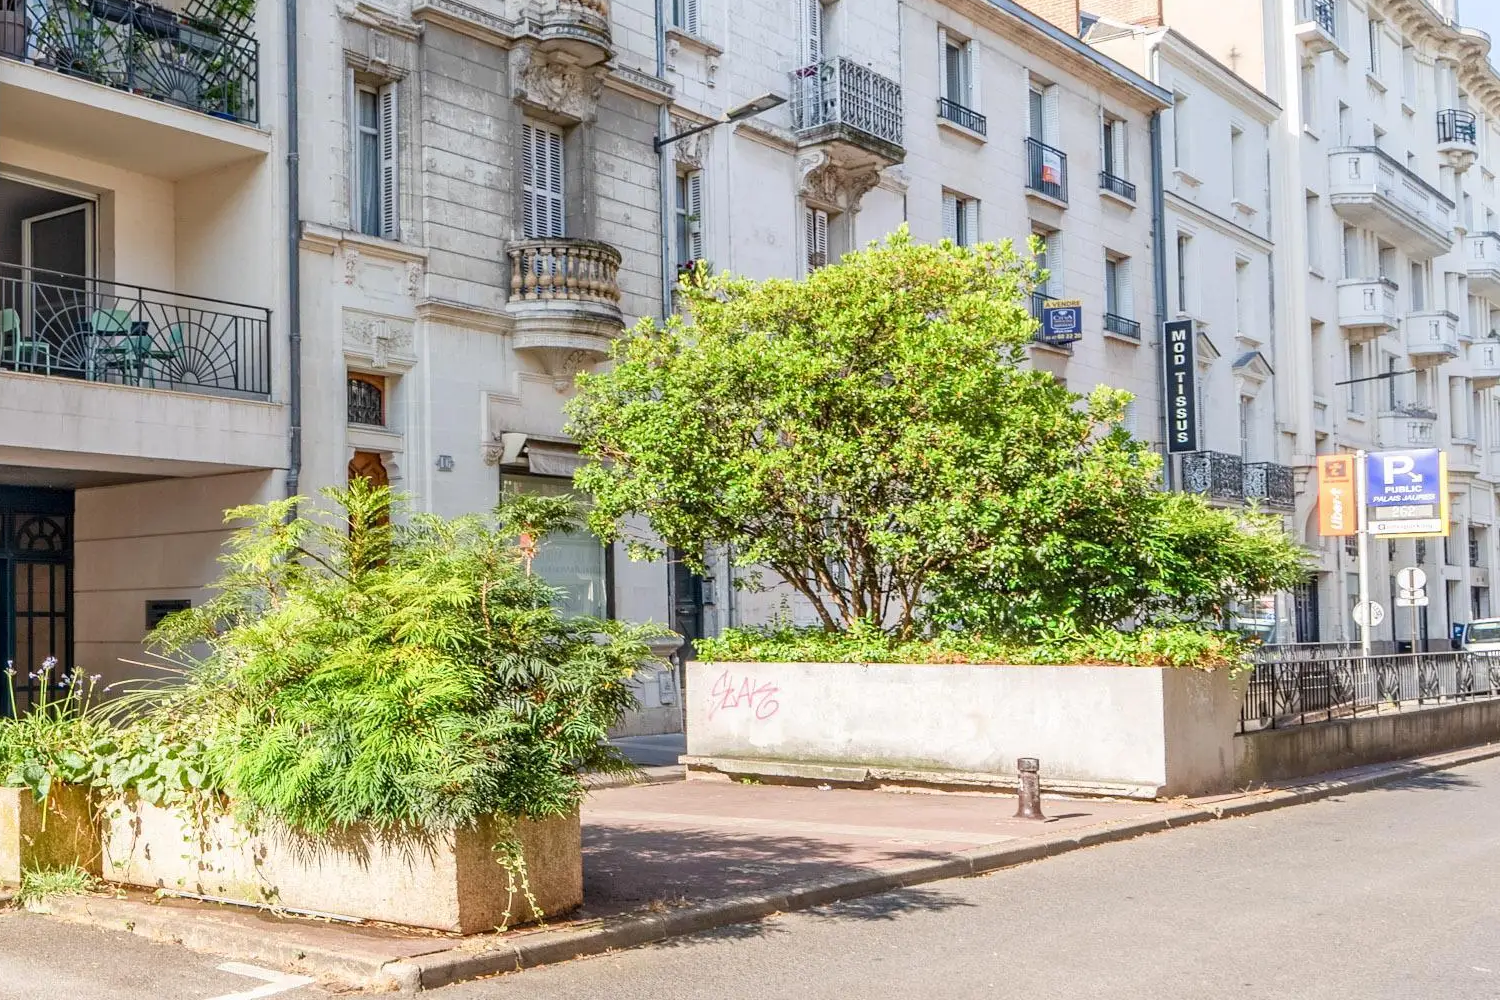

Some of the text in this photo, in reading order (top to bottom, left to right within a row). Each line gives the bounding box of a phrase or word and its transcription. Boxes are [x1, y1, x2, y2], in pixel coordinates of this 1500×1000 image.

[1171, 329, 1189, 443] MOD TISSUS
[1384, 485, 1423, 493] PUBLIC
[1372, 494, 1401, 502] PALAIS
